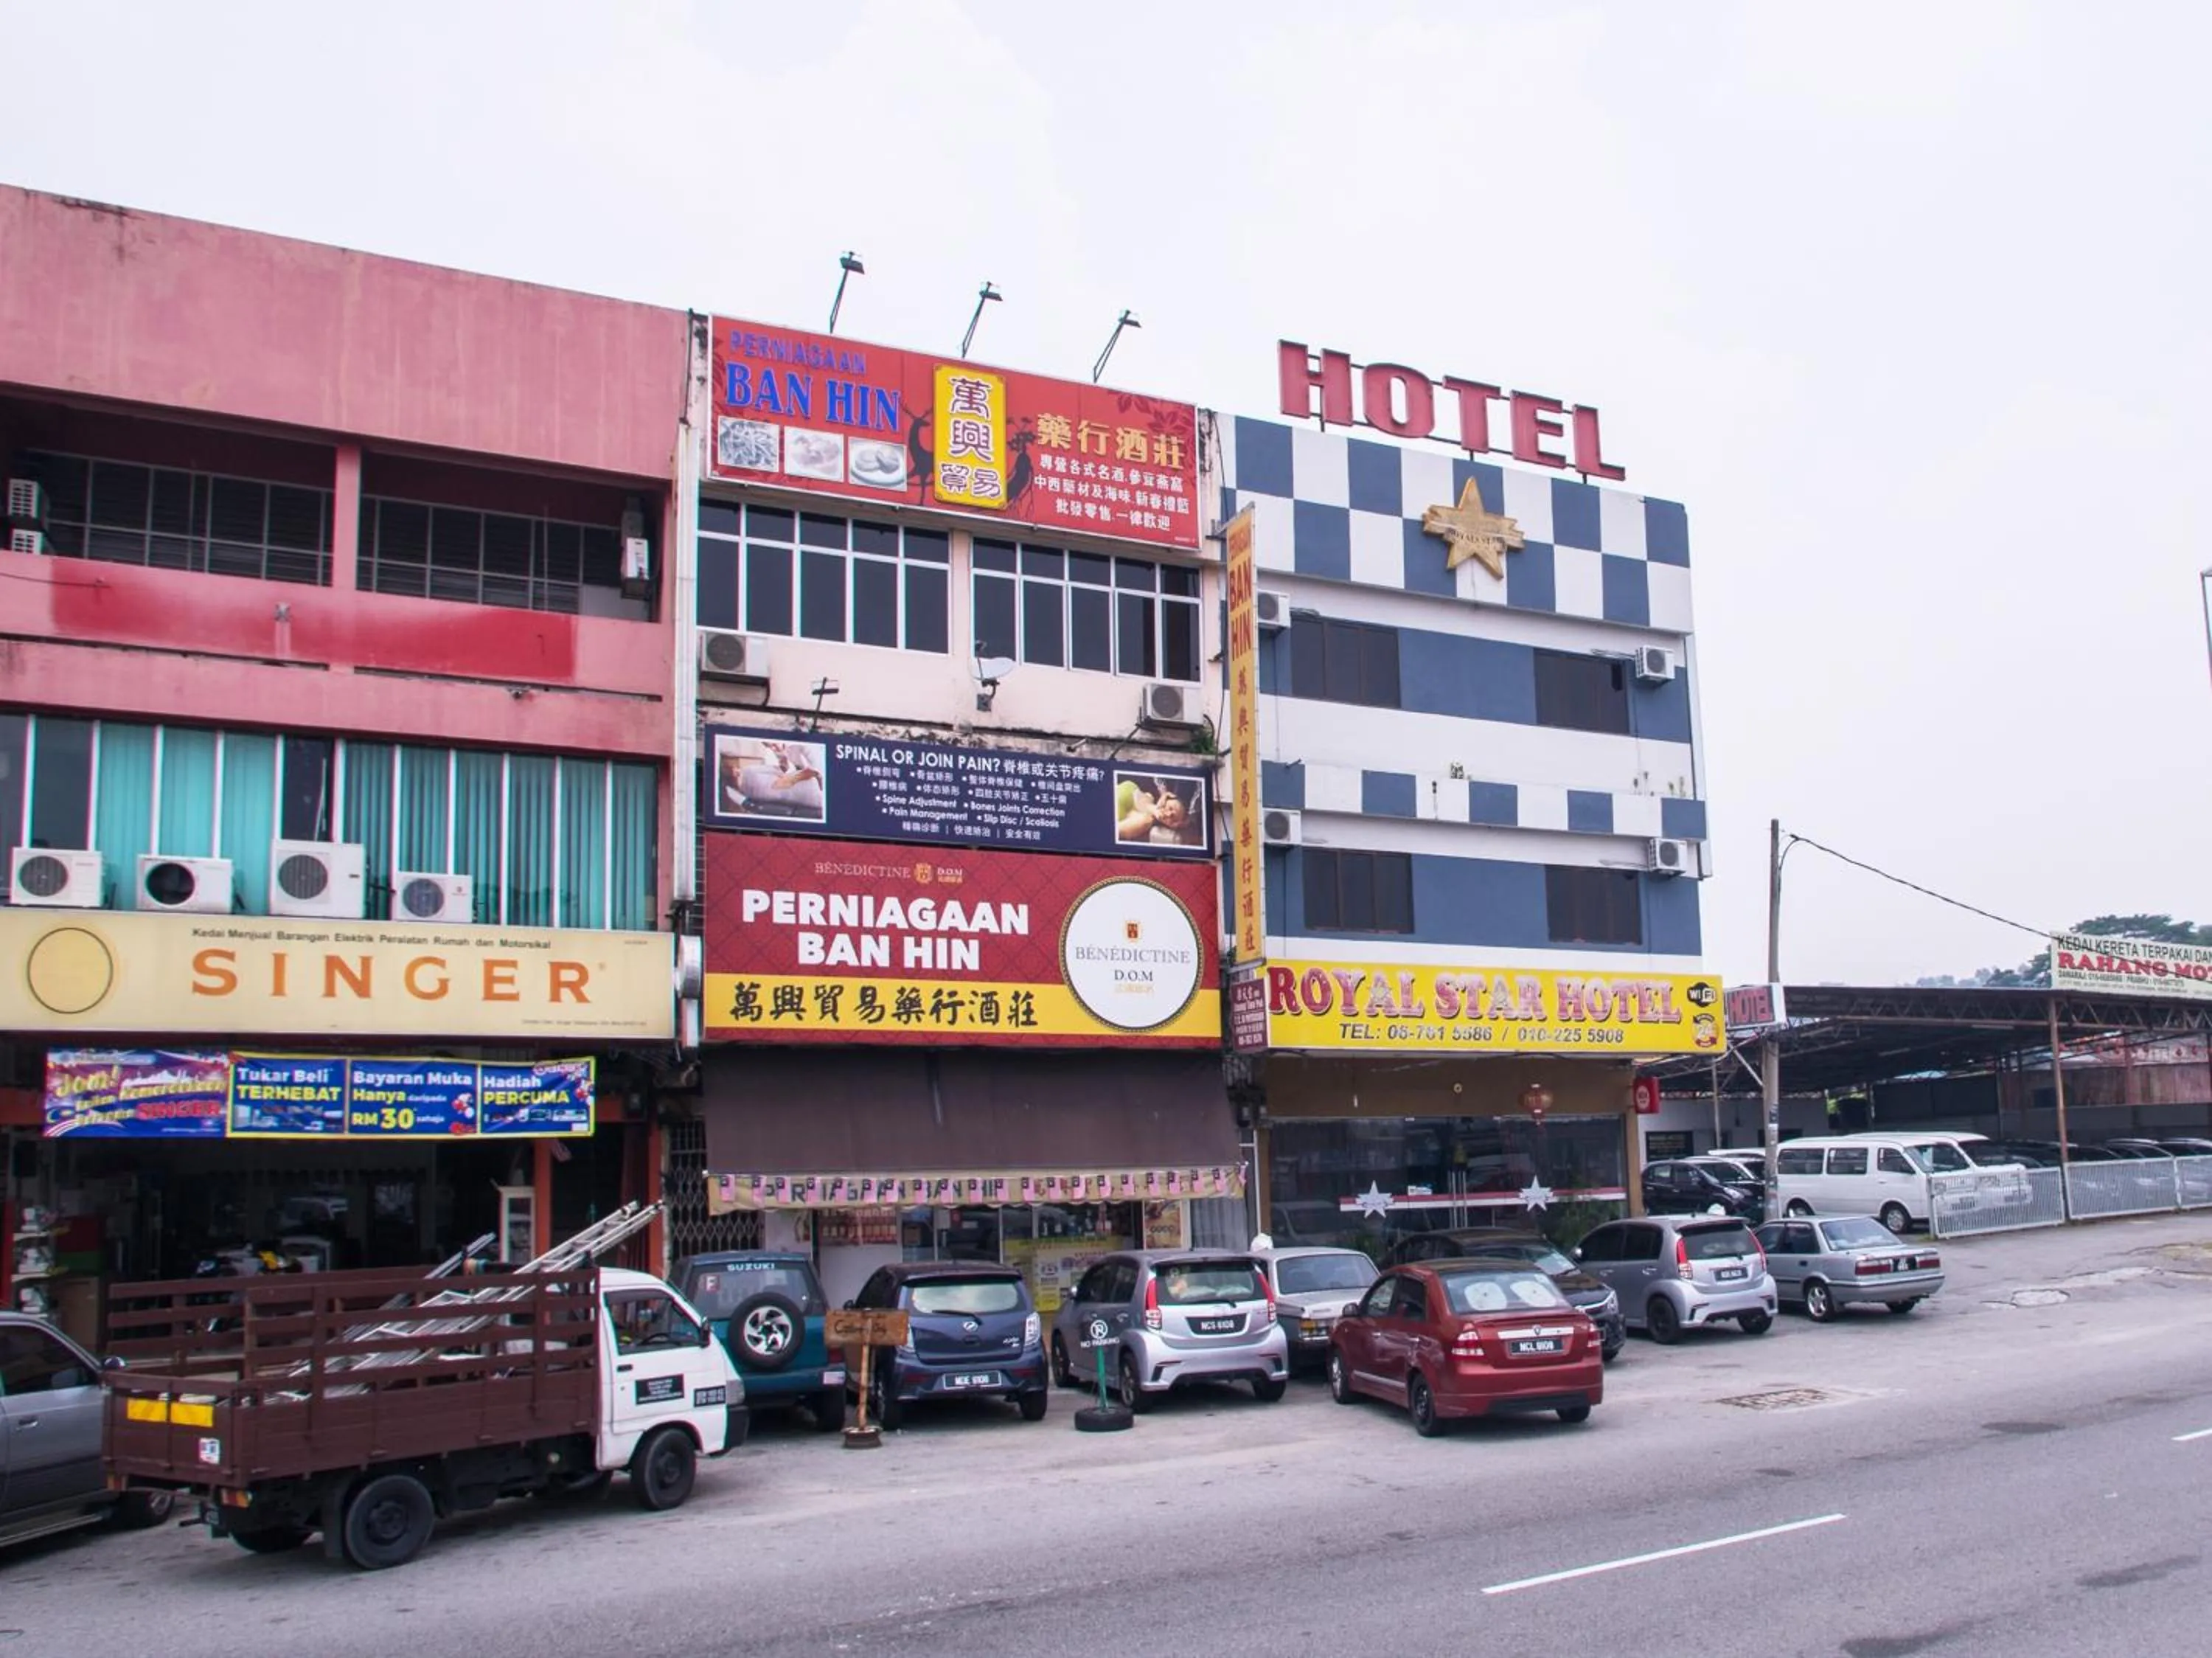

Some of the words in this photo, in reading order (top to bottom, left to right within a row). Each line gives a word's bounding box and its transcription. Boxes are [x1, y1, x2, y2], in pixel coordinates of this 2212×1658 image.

[730, 330, 866, 375] PERNIAGAAN
[725, 360, 812, 421] BAN
[825, 378, 901, 434] HIN
[950, 374, 994, 463] 萬興
[1278, 339, 1626, 481] HOTEL
[1037, 412, 1186, 471] 藥行酒莊
[939, 461, 1003, 499] 貿易
[1229, 557, 1252, 613] BAN
[1231, 608, 1252, 662] HIN
[836, 743, 888, 763] SPINAL
[891, 749, 914, 766] OR
[918, 752, 954, 769] JOIN
[958, 755, 1001, 773] PAIN?
[882, 794, 907, 805] Spine
[908, 796, 957, 809] Adjustment
[970, 800, 995, 812] Bones
[998, 802, 1021, 814] Joints
[1022, 805, 1066, 817] Correction
[888, 806, 908, 816] Pain
[909, 808, 968, 822] Management
[999, 815, 1018, 826] Disc
[742, 889, 1029, 936] PERNIAGAAN
[192, 928, 226, 938] Kedai
[228, 929, 272, 941] Menjual
[276, 930, 330, 943] Barangan
[334, 932, 374, 943] Elektrik
[433, 935, 470, 947] Rumah
[475, 938, 494, 948] dan
[499, 938, 552, 950] Motorsikal
[2057, 934, 2094, 952] KEDAI
[2095, 939, 2139, 957] KERETA
[2140, 943, 2192, 962] TERPAKAI
[797, 932, 891, 968] BAN
[903, 936, 980, 972] HIN
[1075, 943, 1192, 965] BÉNÉDICTINE
[191, 948, 593, 1004] SINGER
[1113, 969, 1154, 982] D.O.M
[2174, 962, 2212, 982] MO
[729, 981, 1039, 1028] 萬興貿易藥行酒莊
[1267, 965, 1425, 1019] ROYAL
[1434, 972, 1548, 1022] STAR
[1556, 977, 1683, 1024] HOTEL
[1339, 1023, 1380, 1041] TEL:
[1587, 1027, 1624, 1044] 5908
[56, 1064, 122, 1098] Jom!
[237, 1066, 290, 1082] Tukar
[294, 1068, 330, 1083] Beli
[352, 1069, 425, 1087] Bayaran
[427, 1072, 473, 1086] Muka
[483, 1075, 543, 1088] Hadiah
[236, 1083, 343, 1101] TERHEBAT
[352, 1088, 407, 1105] Hanya
[483, 1089, 570, 1105] PERCUMA
[134, 1100, 222, 1120] SINGER
[351, 1112, 378, 1126] RM
[380, 1107, 415, 1130] 30
[726, 1262, 775, 1272] SUZUKI
[1080, 1340, 1091, 1348] NO
